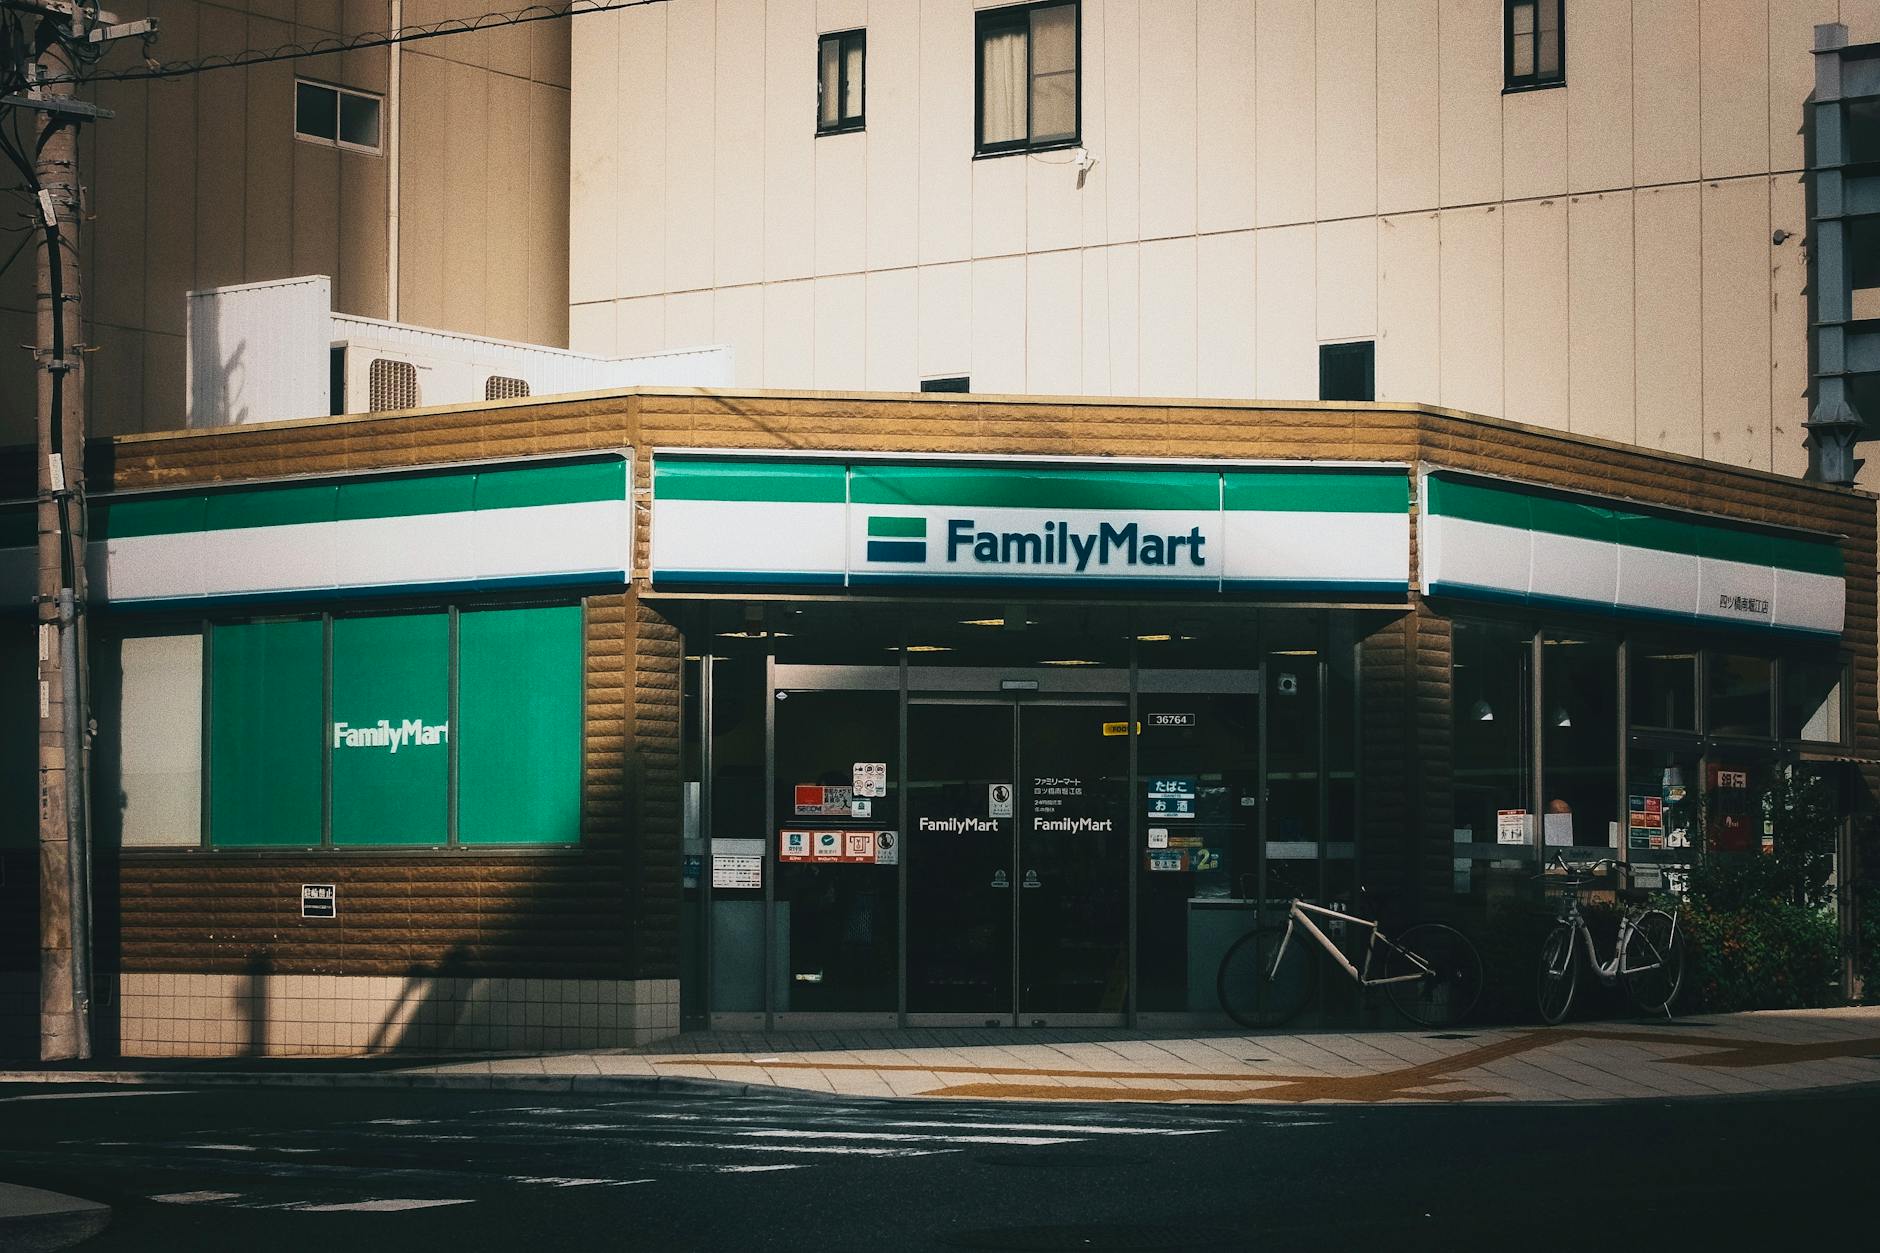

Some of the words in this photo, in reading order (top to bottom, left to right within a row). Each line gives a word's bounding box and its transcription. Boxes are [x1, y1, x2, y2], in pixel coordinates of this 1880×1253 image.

[947, 519, 1206, 572] FamilyMart
[1156, 715, 1187, 724] 36764
[1034, 778, 1081, 786] ファミリーマート
[1155, 780, 1188, 792] たばこ
[919, 817, 999, 834] FamilyMart
[1034, 817, 1112, 834] FamilyMart
